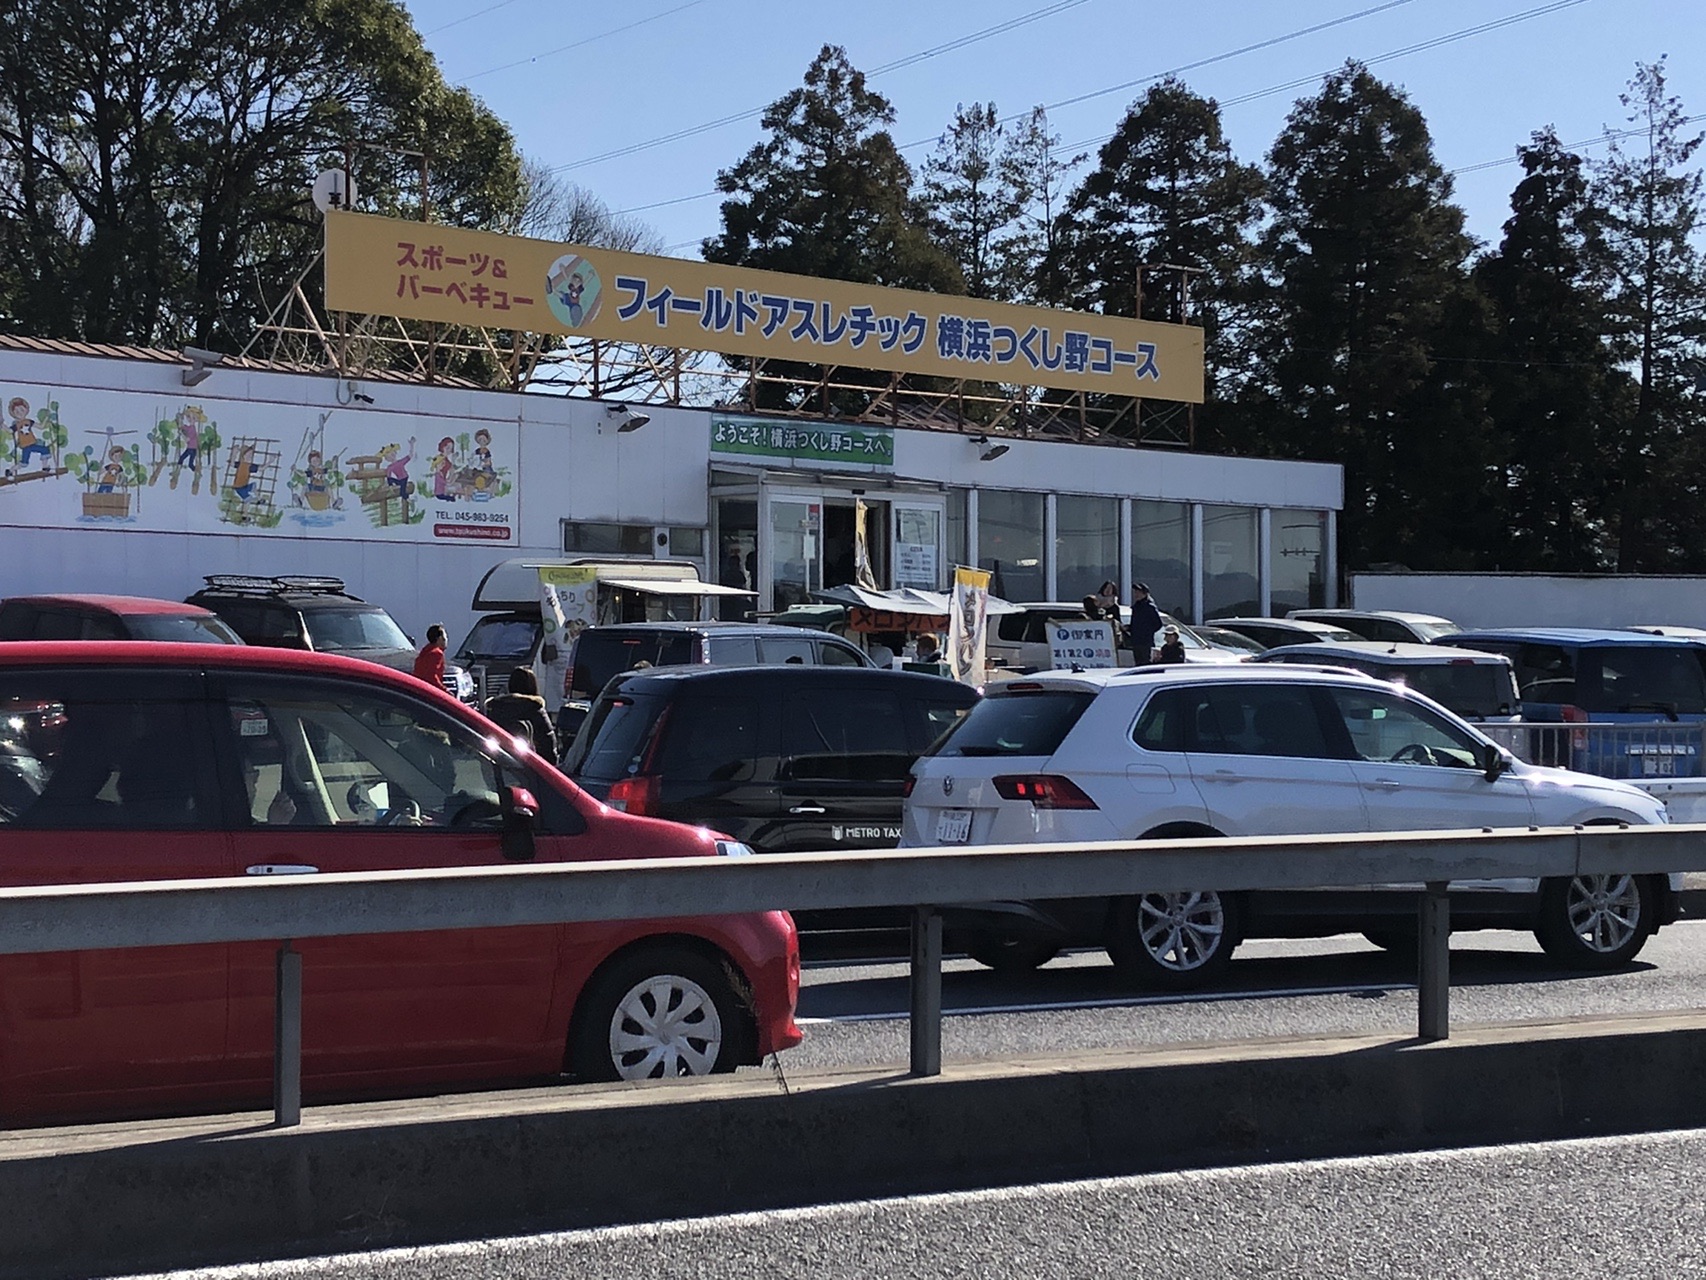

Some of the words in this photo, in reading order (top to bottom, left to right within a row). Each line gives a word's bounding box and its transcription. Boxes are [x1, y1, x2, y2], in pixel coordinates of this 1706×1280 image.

[396, 241, 508, 279] スポーツ&
[396, 274, 534, 311] バーベキュー
[615, 275, 928, 353] フィールドアスレチック
[938, 314, 1160, 382] 横浜つくし野コース
[845, 827, 881, 838] METRO
